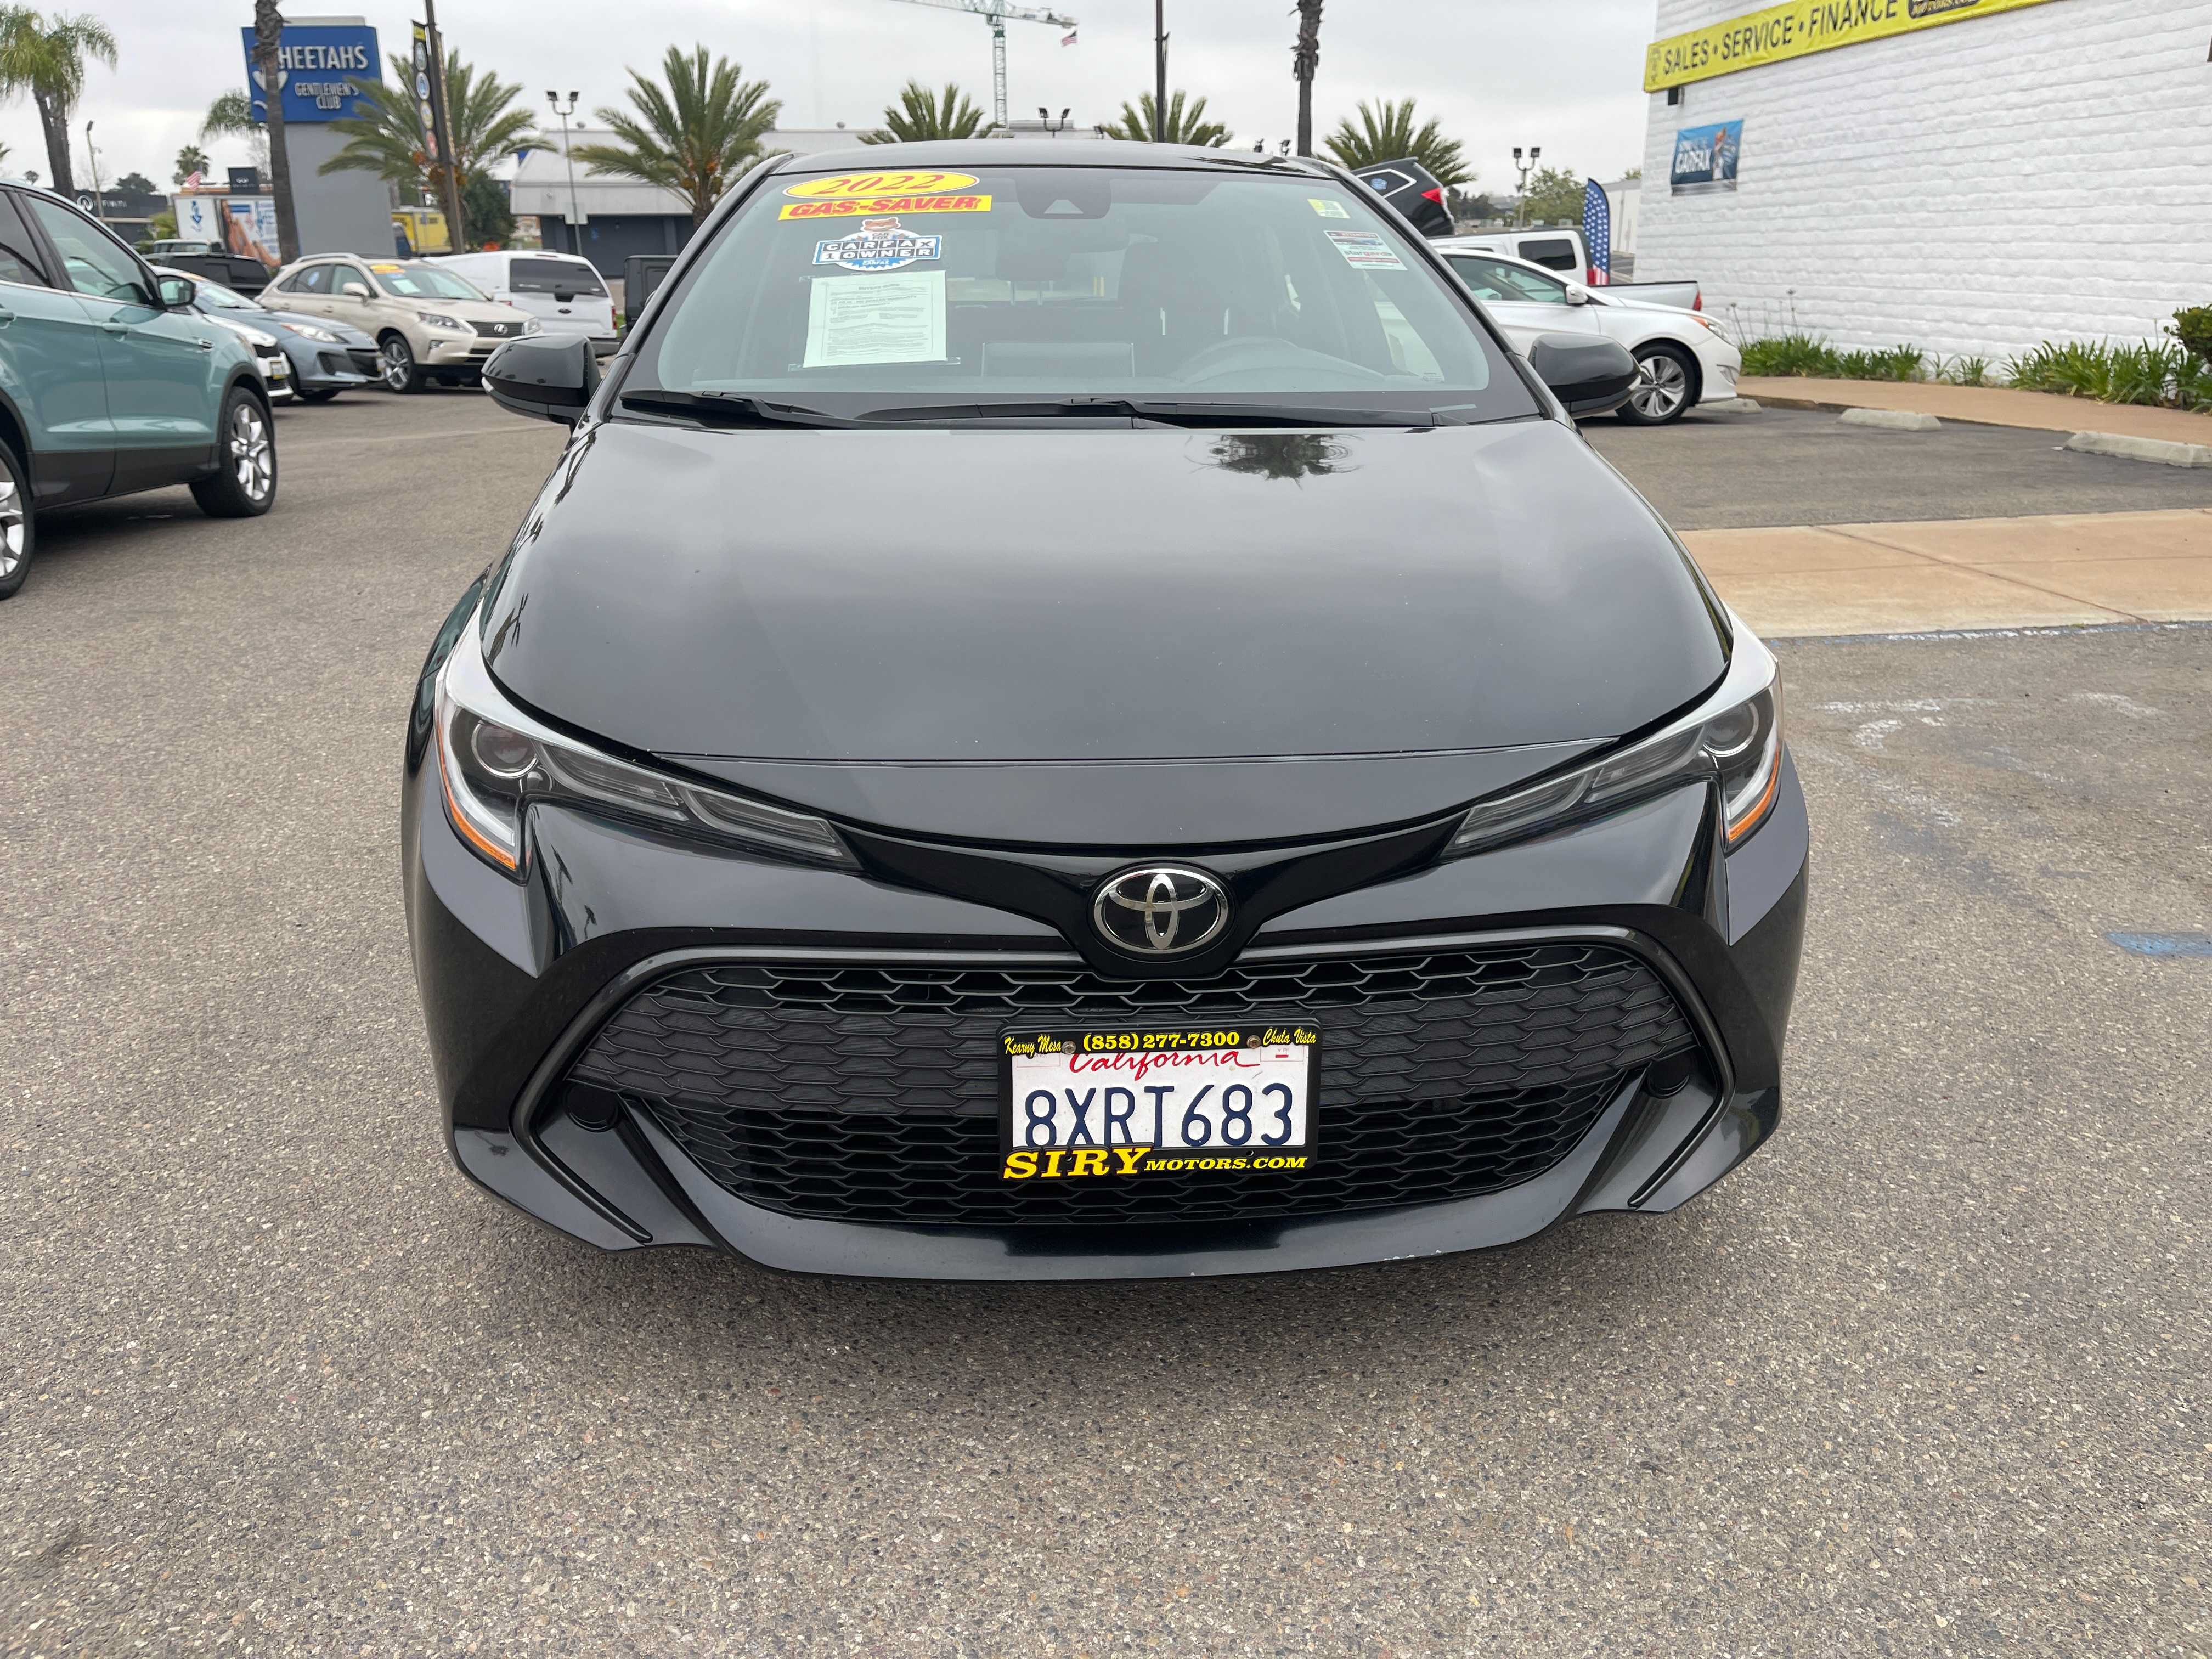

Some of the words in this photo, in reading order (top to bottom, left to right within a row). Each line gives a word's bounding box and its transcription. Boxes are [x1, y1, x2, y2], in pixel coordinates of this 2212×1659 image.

[1663, 38, 1709, 75] SALES
[1722, 15, 1794, 60] SERVICE
[1808, 0, 1898, 38] FINANCE
[279, 46, 369, 70] HEETAHS
[295, 82, 359, 97] GENTLEMEN'S
[315, 95, 342, 110] CLUB
[811, 174, 945, 195] 2022
[788, 196, 983, 216] GAS-SAVER
[825, 239, 934, 252] CARFAX
[842, 248, 932, 259] OWNER
[1005, 1036, 1035, 1057] Kearny
[1037, 1035, 1062, 1053] Mesa
[1083, 1034, 1139, 1052] (858)
[1143, 1032, 1239, 1049] 277-7300
[1263, 1028, 1290, 1045] Chula
[1294, 1028, 1317, 1044] Vista
[1069, 1051, 1260, 1081] California
[1025, 1082, 1293, 1148] 8XRT683
[1003, 1147, 1152, 1178] SIRY
[1144, 1156, 1307, 1171] MOTORS.COM
